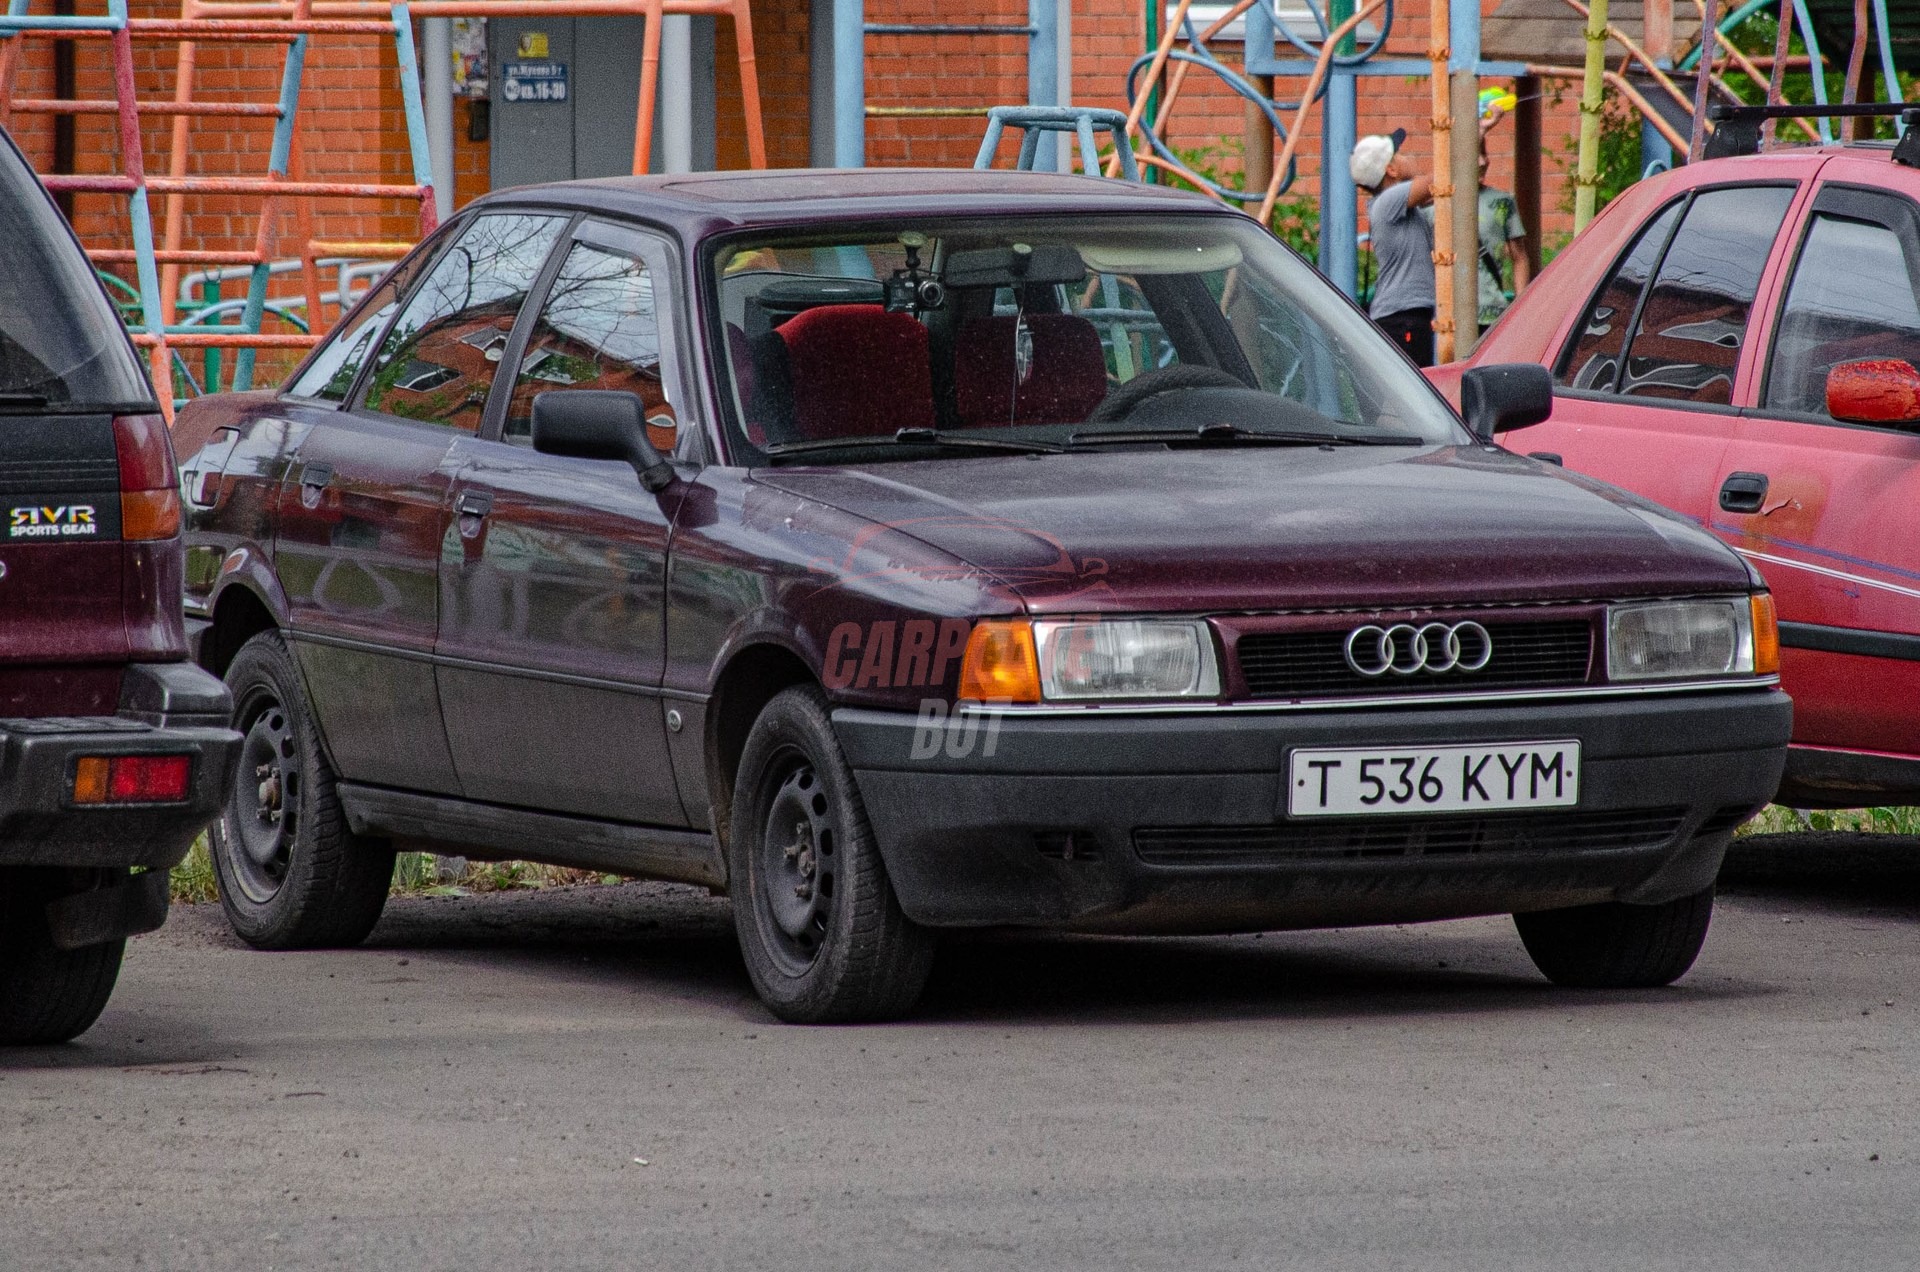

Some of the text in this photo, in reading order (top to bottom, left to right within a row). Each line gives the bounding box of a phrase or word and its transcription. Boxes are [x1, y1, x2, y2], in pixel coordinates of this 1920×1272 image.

[10, 523, 96, 537] SPORTS GEAR
[1308, 752, 1563, 807] T 536 KYM
